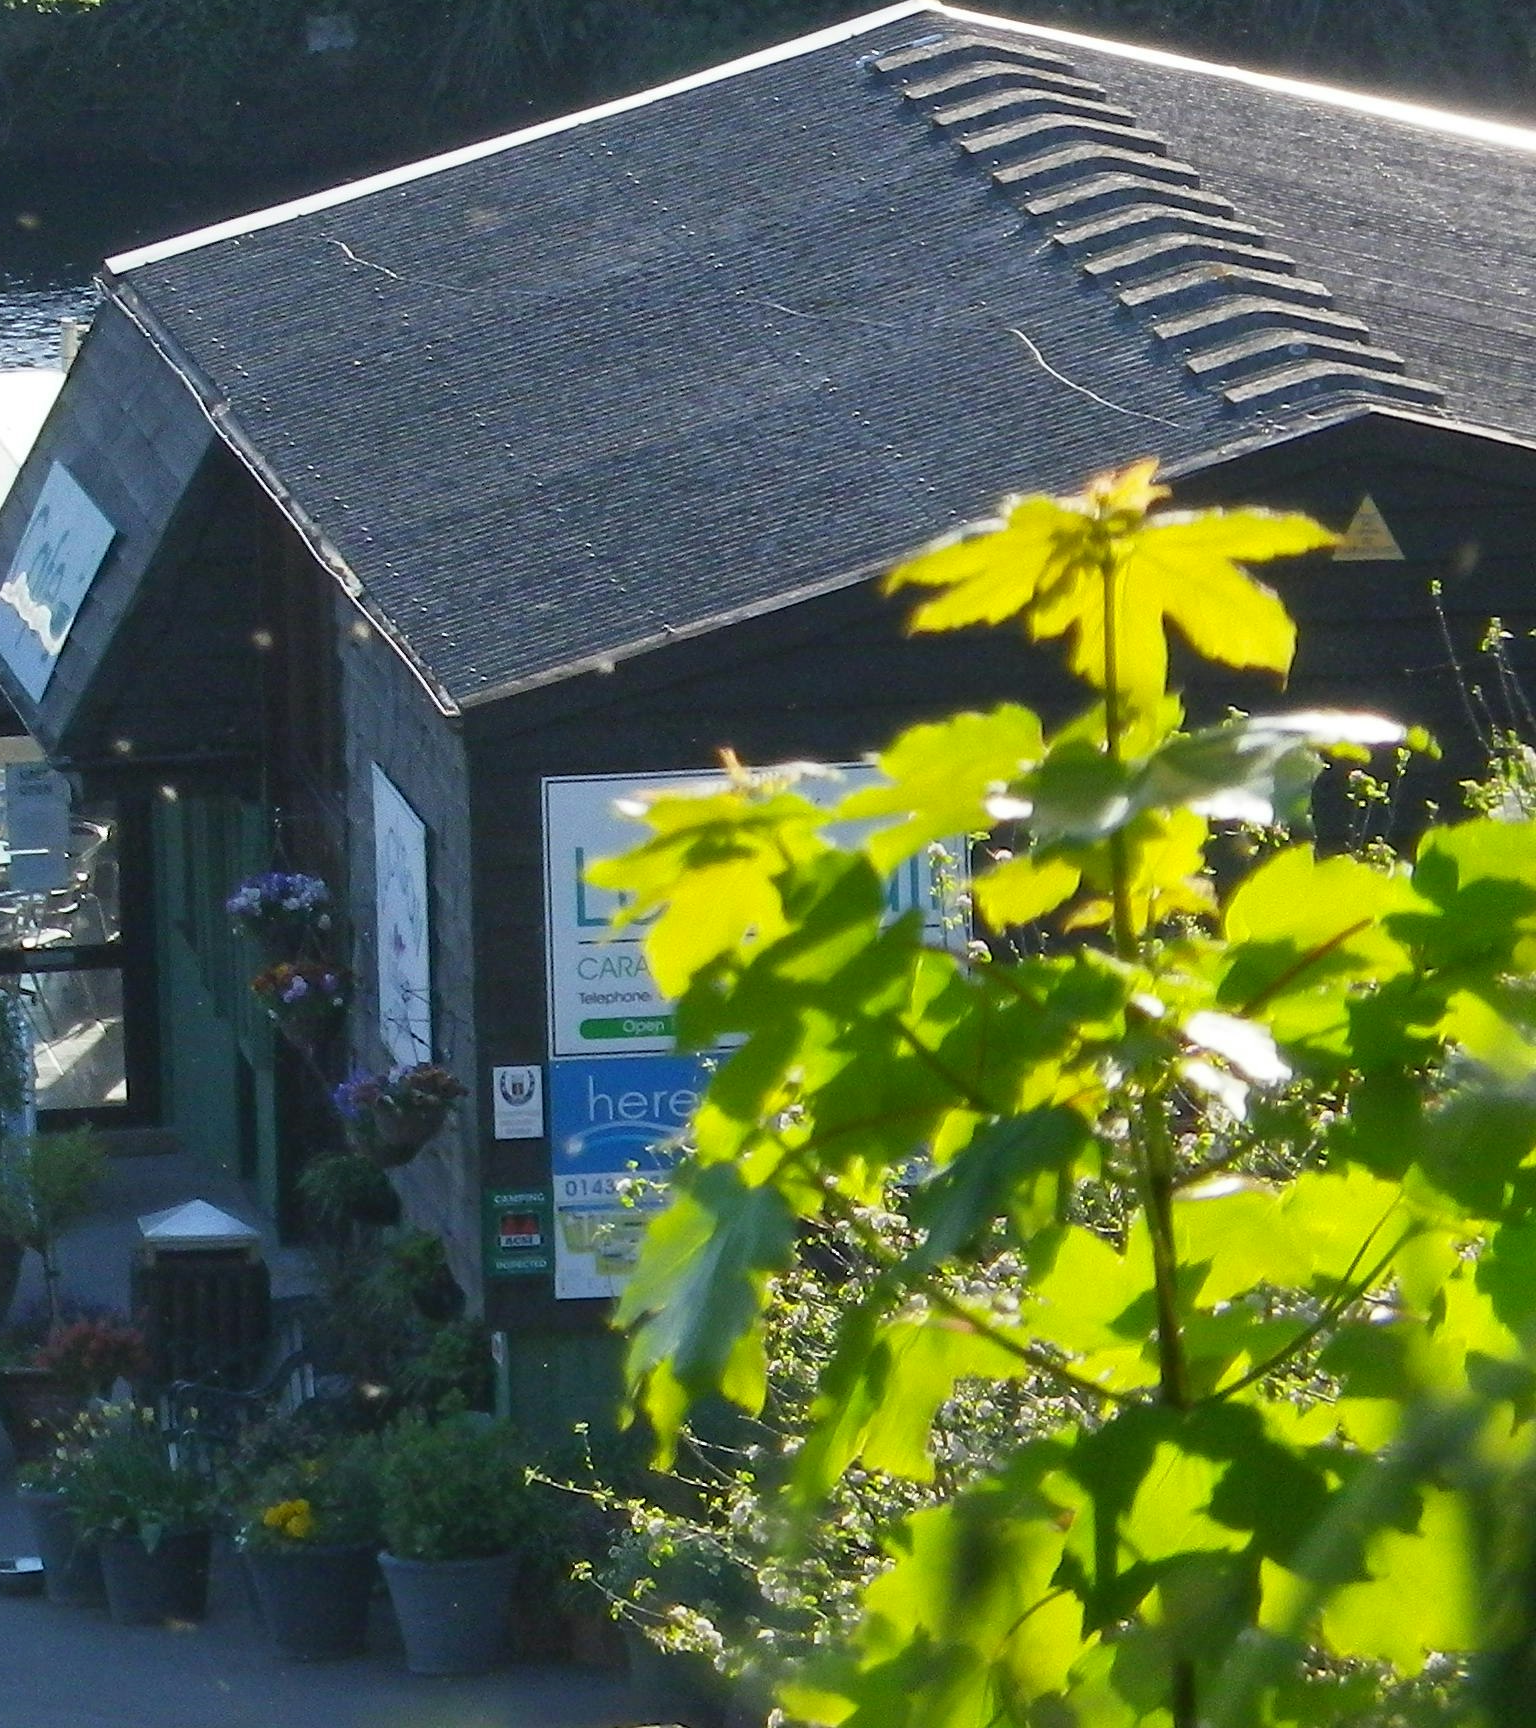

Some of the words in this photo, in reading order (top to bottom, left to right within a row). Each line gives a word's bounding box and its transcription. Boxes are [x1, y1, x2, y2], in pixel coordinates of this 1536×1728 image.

[578, 955, 652, 981] CARA
[622, 1019, 665, 1033] Open
[588, 1075, 700, 1121] here
[565, 1179, 615, 1197] 0143
[494, 1192, 545, 1205] CAMPING
